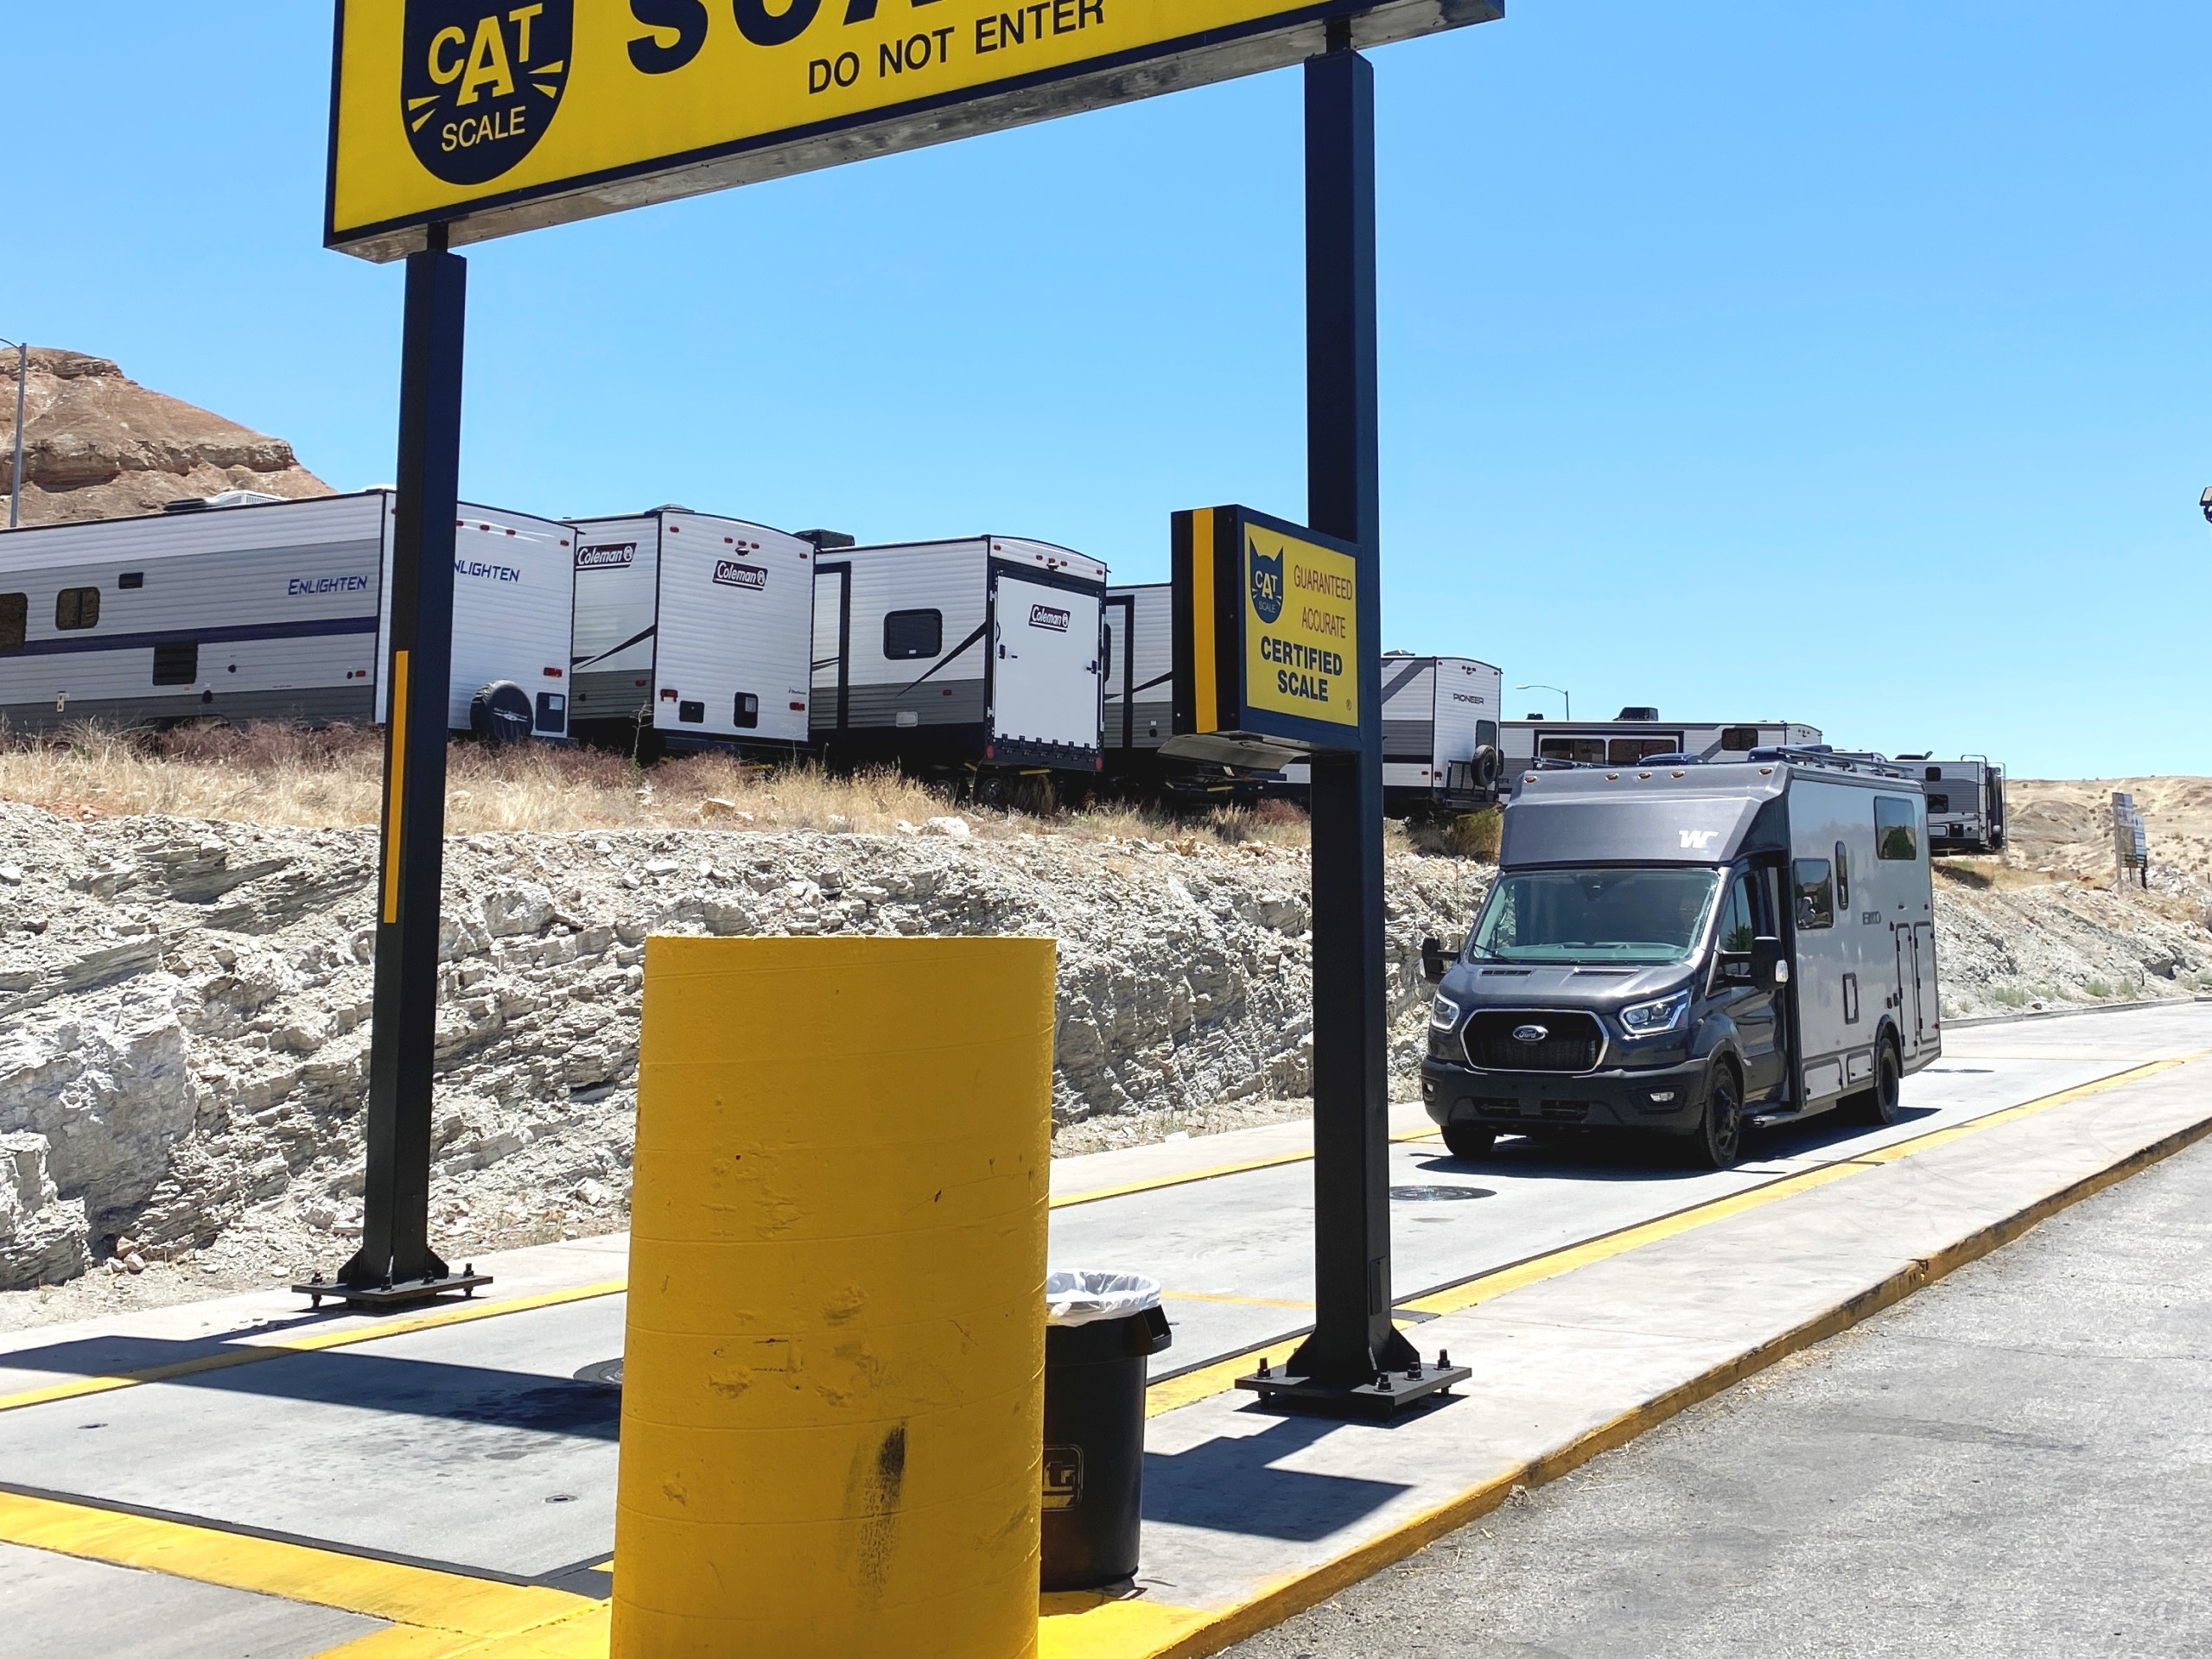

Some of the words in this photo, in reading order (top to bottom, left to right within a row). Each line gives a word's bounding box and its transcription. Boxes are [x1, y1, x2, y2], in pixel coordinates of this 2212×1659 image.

[428, 3, 543, 107] CAT
[809, 51, 860, 95] DO
[879, 26, 955, 78] NOT
[975, 0, 1104, 55] ENTER
[442, 105, 525, 152] SCALE
[454, 559, 520, 582] NLIGHTEN
[577, 547, 622, 565] Coleman
[288, 575, 367, 595] ENLIGHTEN
[717, 562, 757, 583] Coleman
[1255, 570, 1278, 600] CAT
[1294, 564, 1353, 601] GUARANTEED
[1032, 606, 1062, 626] Coleman
[1258, 601, 1275, 613] SCALE
[1302, 607, 1346, 639] ACCURATE
[1261, 636, 1343, 676] CERTIFIED
[1277, 669, 1328, 702] SCALE
[1452, 693, 1484, 704] PIONEER
